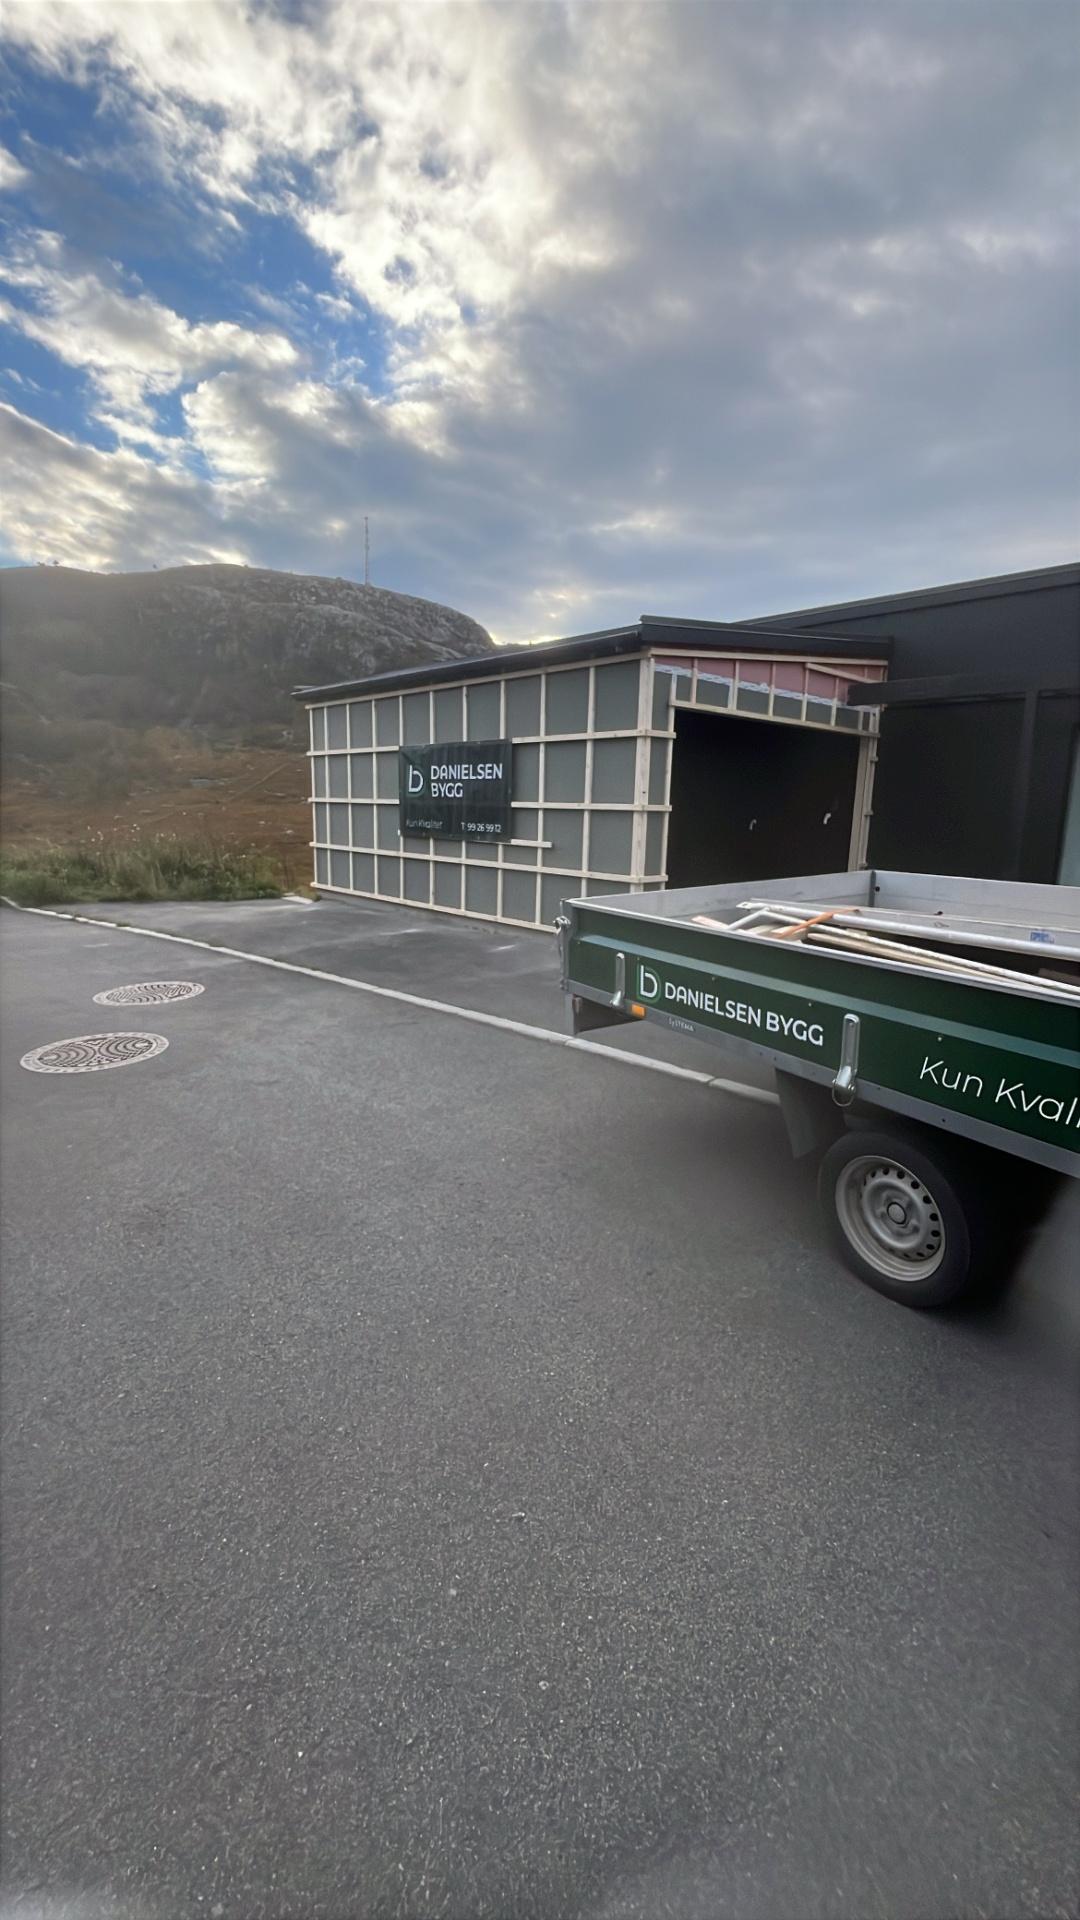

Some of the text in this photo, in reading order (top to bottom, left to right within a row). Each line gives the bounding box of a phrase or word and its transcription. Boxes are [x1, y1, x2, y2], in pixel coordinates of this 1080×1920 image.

[430, 763, 503, 780] DANIELSEN
[431, 782, 464, 798] BYGG
[460, 821, 502, 833] T 99 26 99 12
[664, 982, 761, 1028] DANIELSEN
[766, 1011, 824, 1047] BYGG
[919, 1056, 984, 1098] Kun
